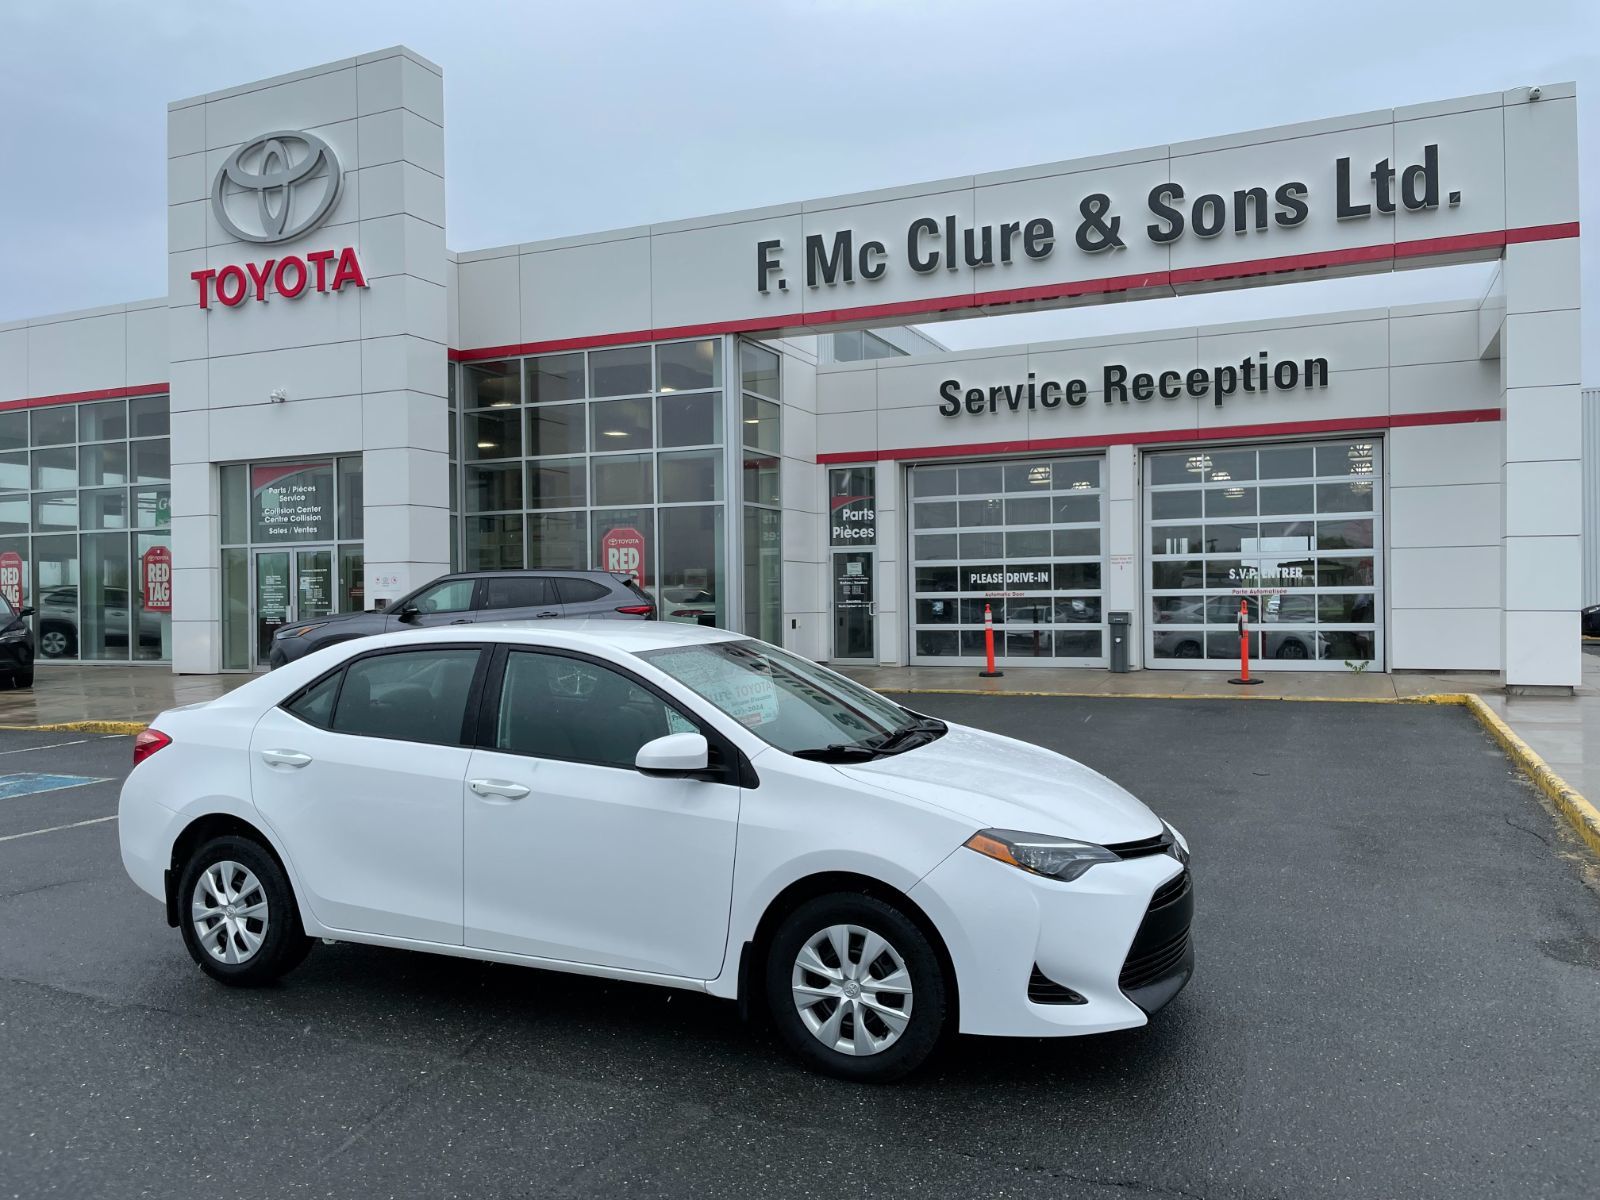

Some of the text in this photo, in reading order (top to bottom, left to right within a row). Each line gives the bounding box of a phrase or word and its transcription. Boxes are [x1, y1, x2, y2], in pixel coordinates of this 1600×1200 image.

[757, 143, 1461, 293] F. Mc Clure & Sons Ltd.
[191, 247, 369, 310] TOYOTA
[938, 350, 1329, 417] Service Reception
[279, 494, 306, 502] Service
[264, 506, 322, 515] Collision Center
[842, 507, 875, 521] Parts
[264, 514, 322, 523] Centre Collision
[268, 527, 288, 535] Sales
[293, 526, 318, 534] Ventes
[832, 524, 875, 539] Pièces
[608, 547, 640, 570] RED
[0, 567, 19, 585] RED
[147, 563, 170, 582] RED
[970, 571, 1049, 584] PLEASE DRIVE-IN
[1261, 567, 1303, 579] ENTRER
[147, 582, 170, 601] TAG
[736, 681, 773, 697] TOYOTA
